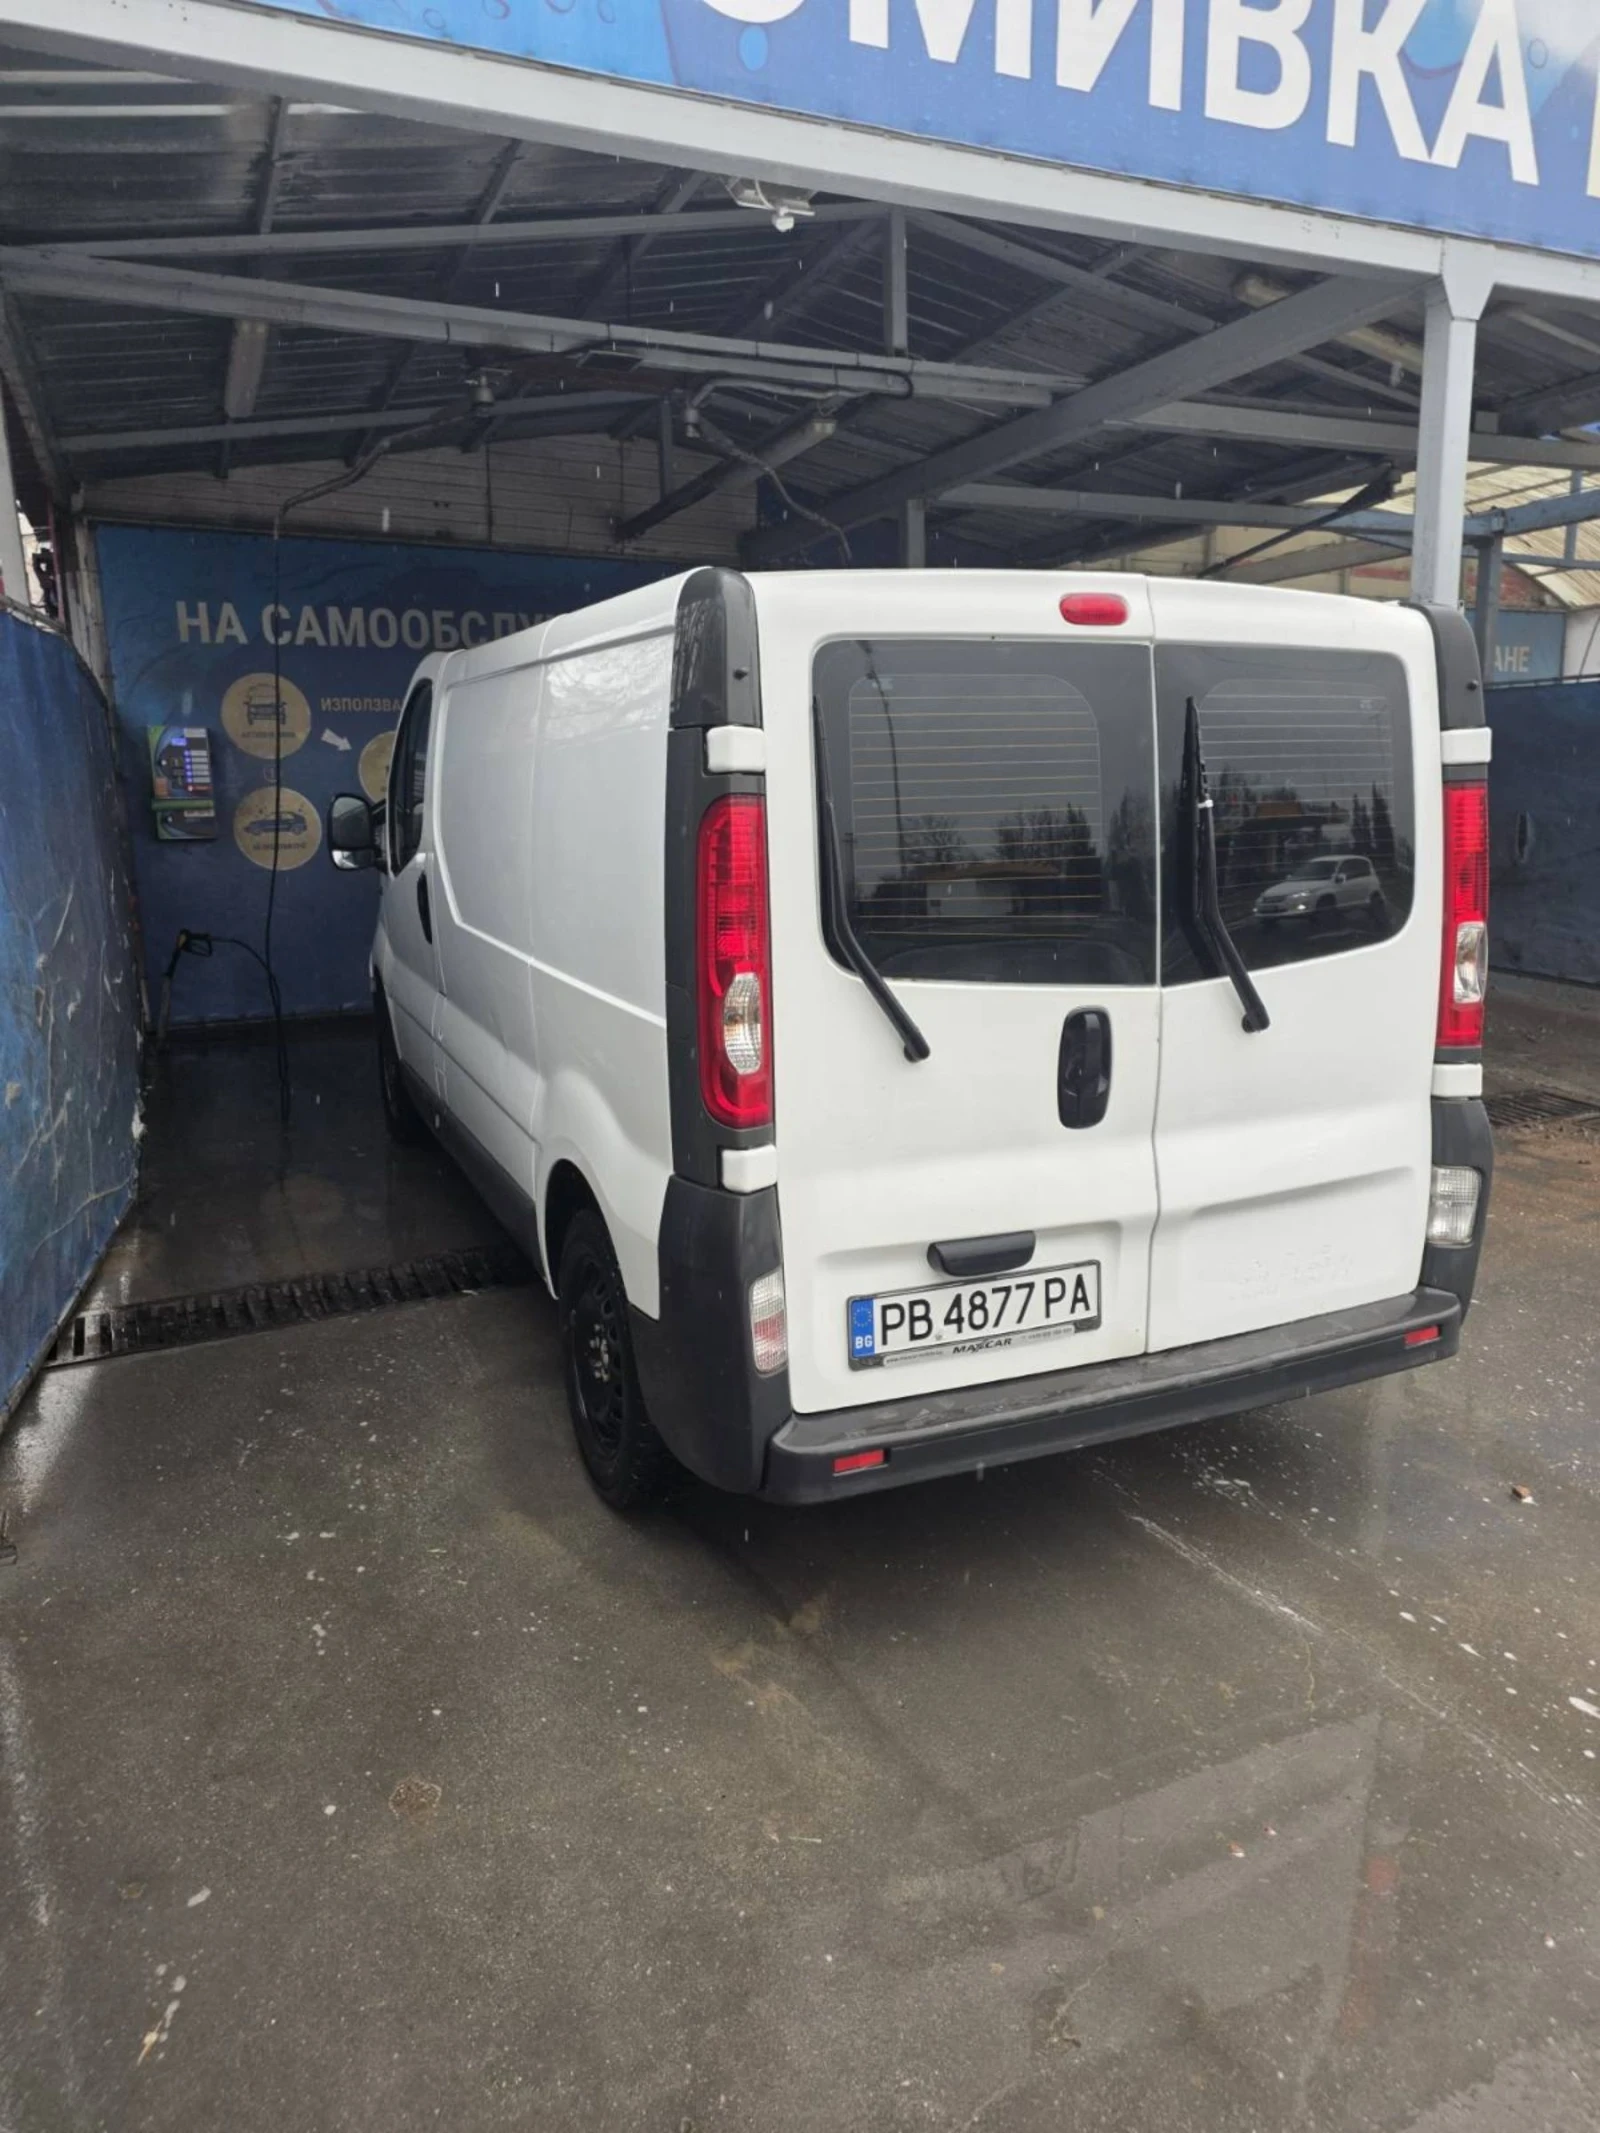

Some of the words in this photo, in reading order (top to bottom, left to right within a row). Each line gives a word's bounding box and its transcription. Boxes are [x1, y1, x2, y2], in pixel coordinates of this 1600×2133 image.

[176, 601, 247, 645] НА
[880, 1299, 933, 1346] PB
[943, 1282, 1035, 1334] 4877
[1044, 1274, 1090, 1319] PA
[855, 1335, 873, 1349] BG
